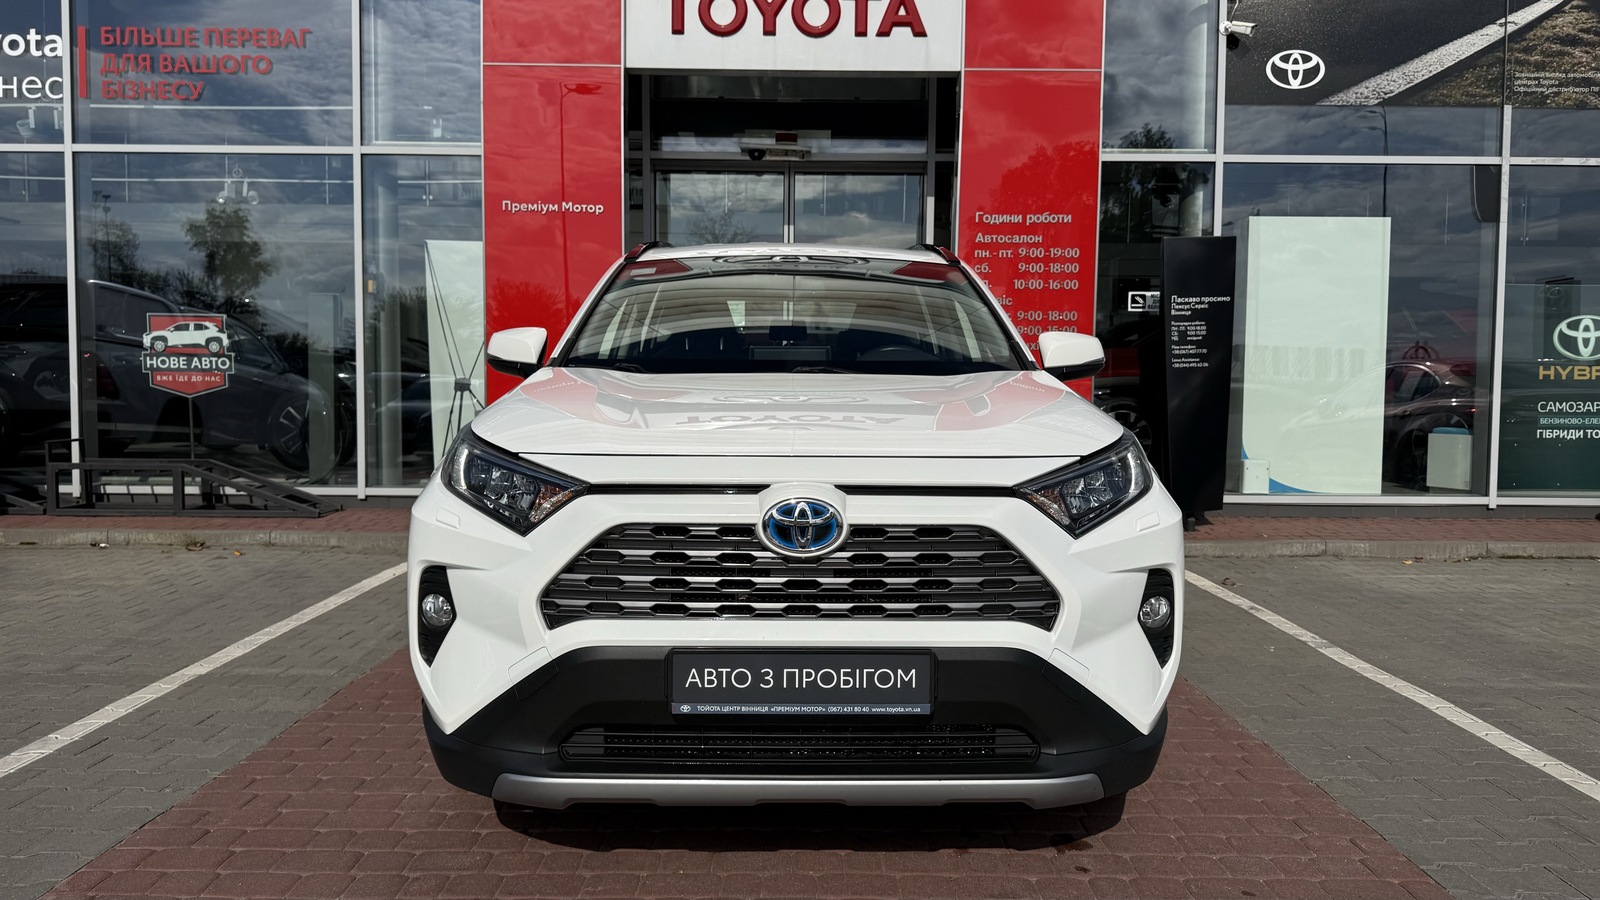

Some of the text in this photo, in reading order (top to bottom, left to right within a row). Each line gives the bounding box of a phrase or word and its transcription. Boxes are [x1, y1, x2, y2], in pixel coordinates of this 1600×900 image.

[670, 0, 929, 37] TOYOTA
[0, 28, 63, 57] ota
[100, 26, 311, 48] БІЛЬШЕ ПЕРЕВАГ
[100, 53, 272, 75] ДЛЯ ВАШОГО
[101, 80, 205, 100] БІЗНЕСУ
[502, 200, 604, 215] Преміум Мотор
[975, 212, 1072, 226] Години роботи
[975, 233, 1042, 243] Автосалон
[974, 263, 992, 273] сб.
[1201, 296, 1231, 304] просимо
[146, 356, 230, 369] НОВЕ АВТО
[175, 374, 188, 382] ЇДЕ
[1537, 401, 1600, 412] САМОЗАР
[1536, 429, 1584, 440] ГІБРИДИ
[685, 668, 752, 688] АВТО
[783, 668, 916, 688] ПРОБІГОМ
[697, 704, 720, 712] ТОЙОТА
[721, 705, 741, 713] ЦЕНТР
[741, 705, 769, 713] ВІННИЦЯ
